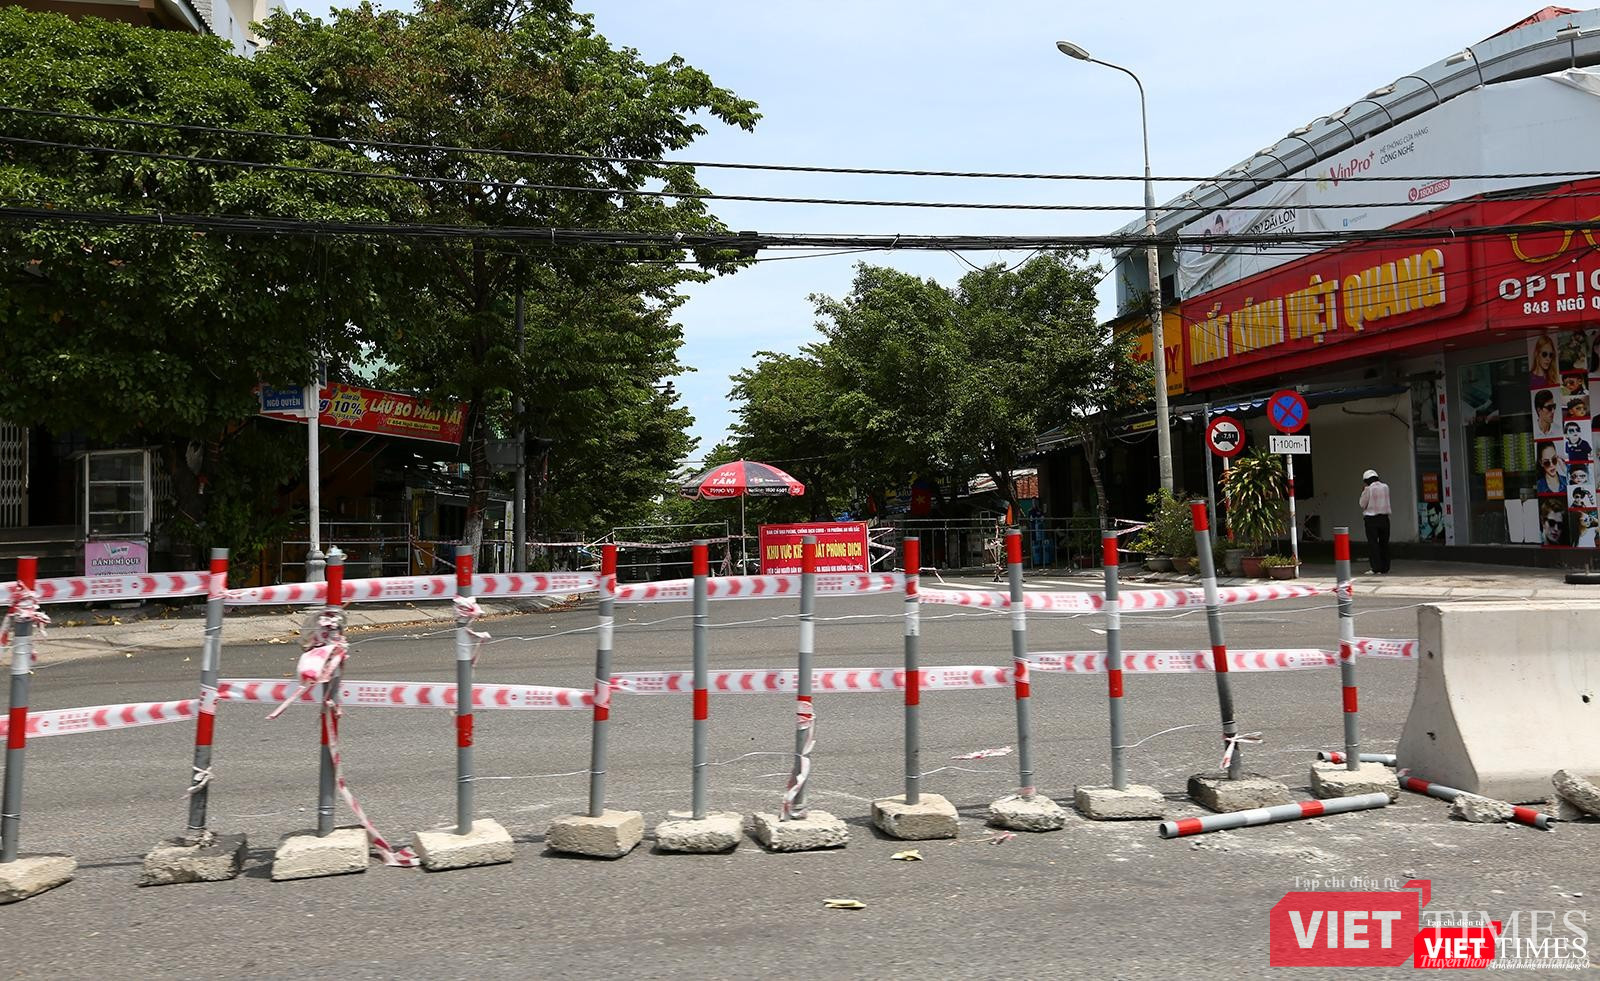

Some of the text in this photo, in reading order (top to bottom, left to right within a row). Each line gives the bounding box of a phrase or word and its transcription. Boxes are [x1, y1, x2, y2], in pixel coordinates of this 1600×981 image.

[1380, 142, 1415, 165] CÔNG NGHỆ
[1189, 301, 1230, 366] MẮT
[1231, 296, 1285, 355] KÍNH
[1285, 274, 1340, 344] VIỆT
[1343, 248, 1447, 332] QUANG
[1523, 300, 1549, 315] 848
[1556, 294, 1586, 312] NGÔ
[266, 395, 301, 407] NGÔ QUYỀN
[334, 400, 362, 416] 10%
[712, 477, 737, 485] TÂM
[767, 545, 779, 560] KHU
[780, 543, 792, 563] VỰC
[793, 537, 803, 559] KIỂ
[826, 539, 847, 558] PHÒNG
[847, 542, 862, 560] DỊCH
